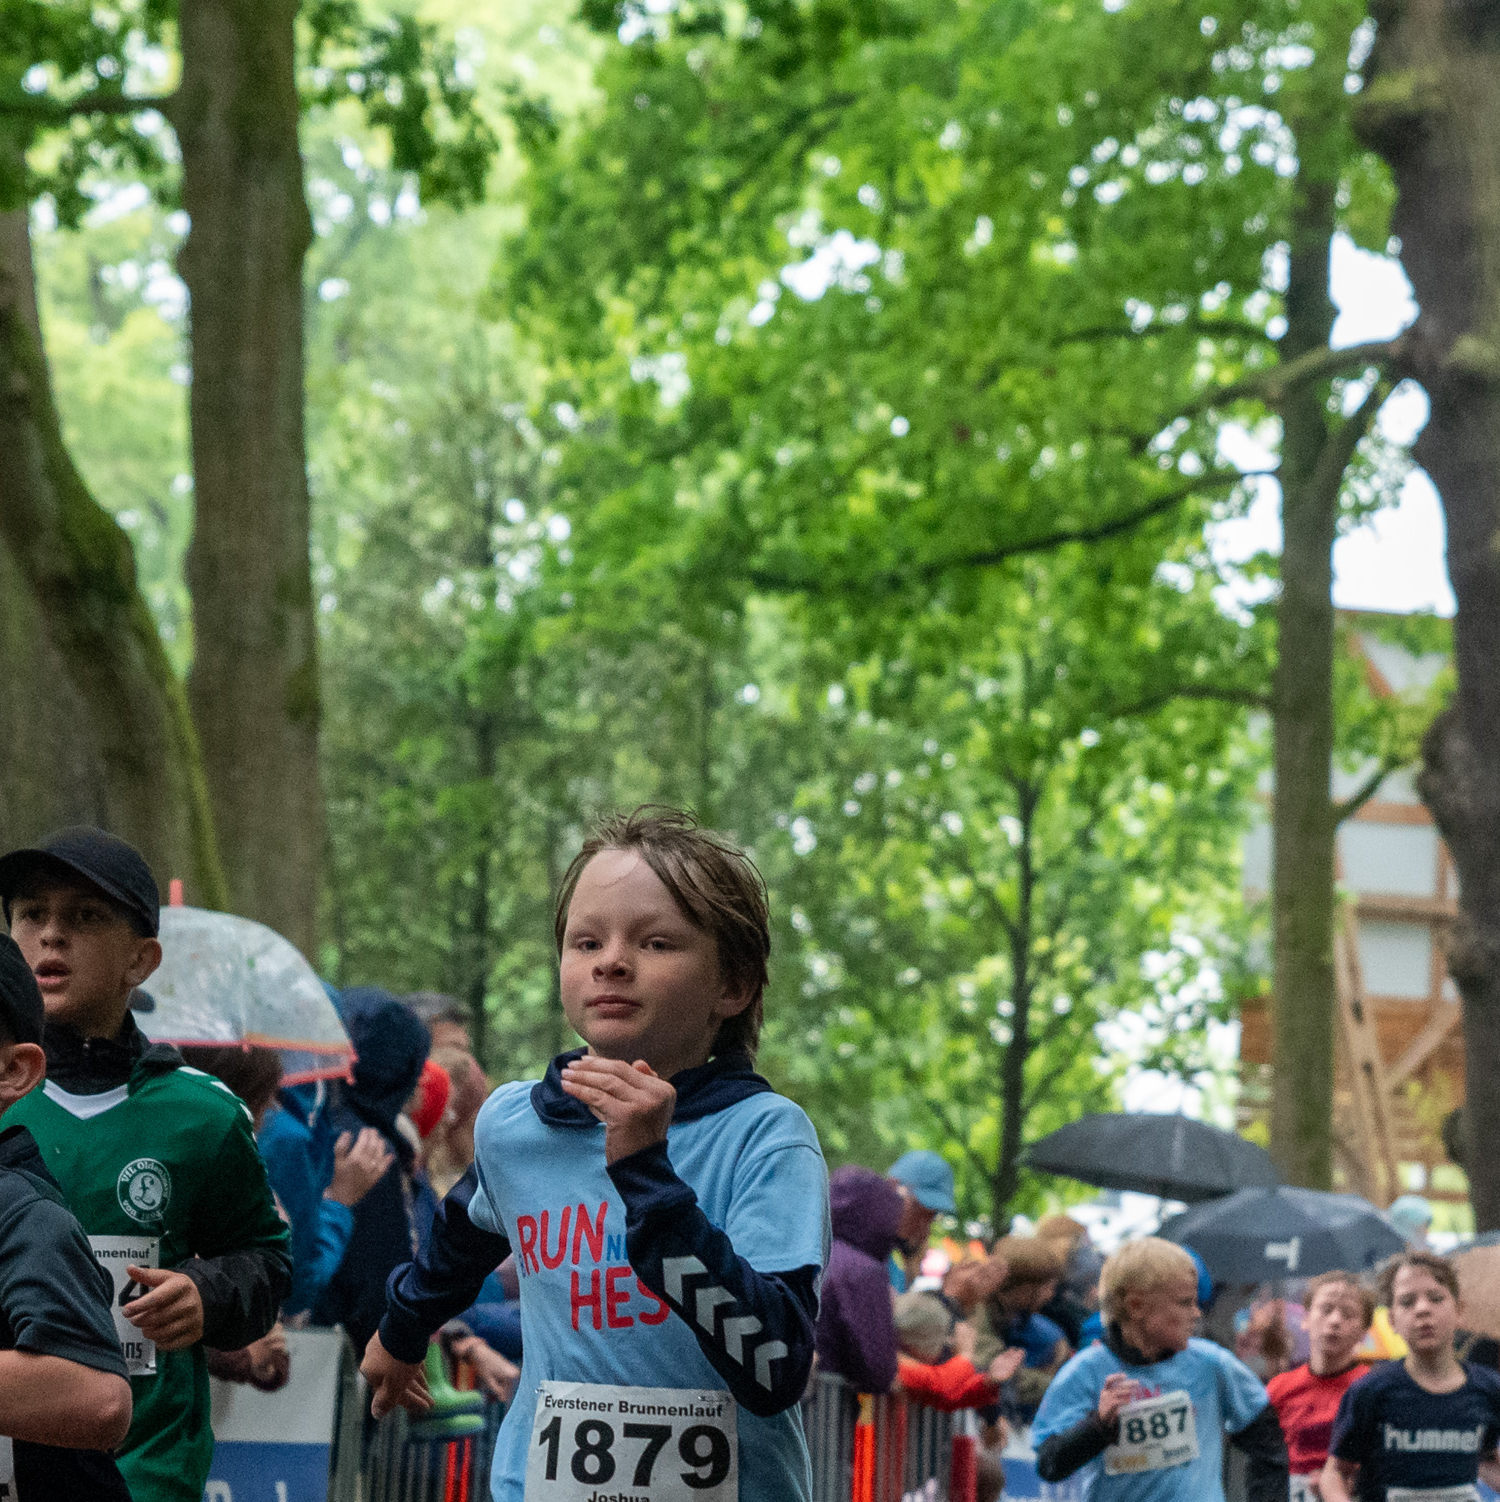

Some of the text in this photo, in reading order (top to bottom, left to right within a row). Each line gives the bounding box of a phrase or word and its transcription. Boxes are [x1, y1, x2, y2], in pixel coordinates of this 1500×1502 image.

[94, 1248, 149, 1259] nnenlauf
[517, 1201, 608, 1276] RUN
[571, 1266, 670, 1332] HES
[545, 1395, 723, 1418] Everstener Brunnenlauf
[1126, 1405, 1188, 1444] 887
[539, 1416, 731, 1489] 1879
[1384, 1422, 1485, 1452] hummel
